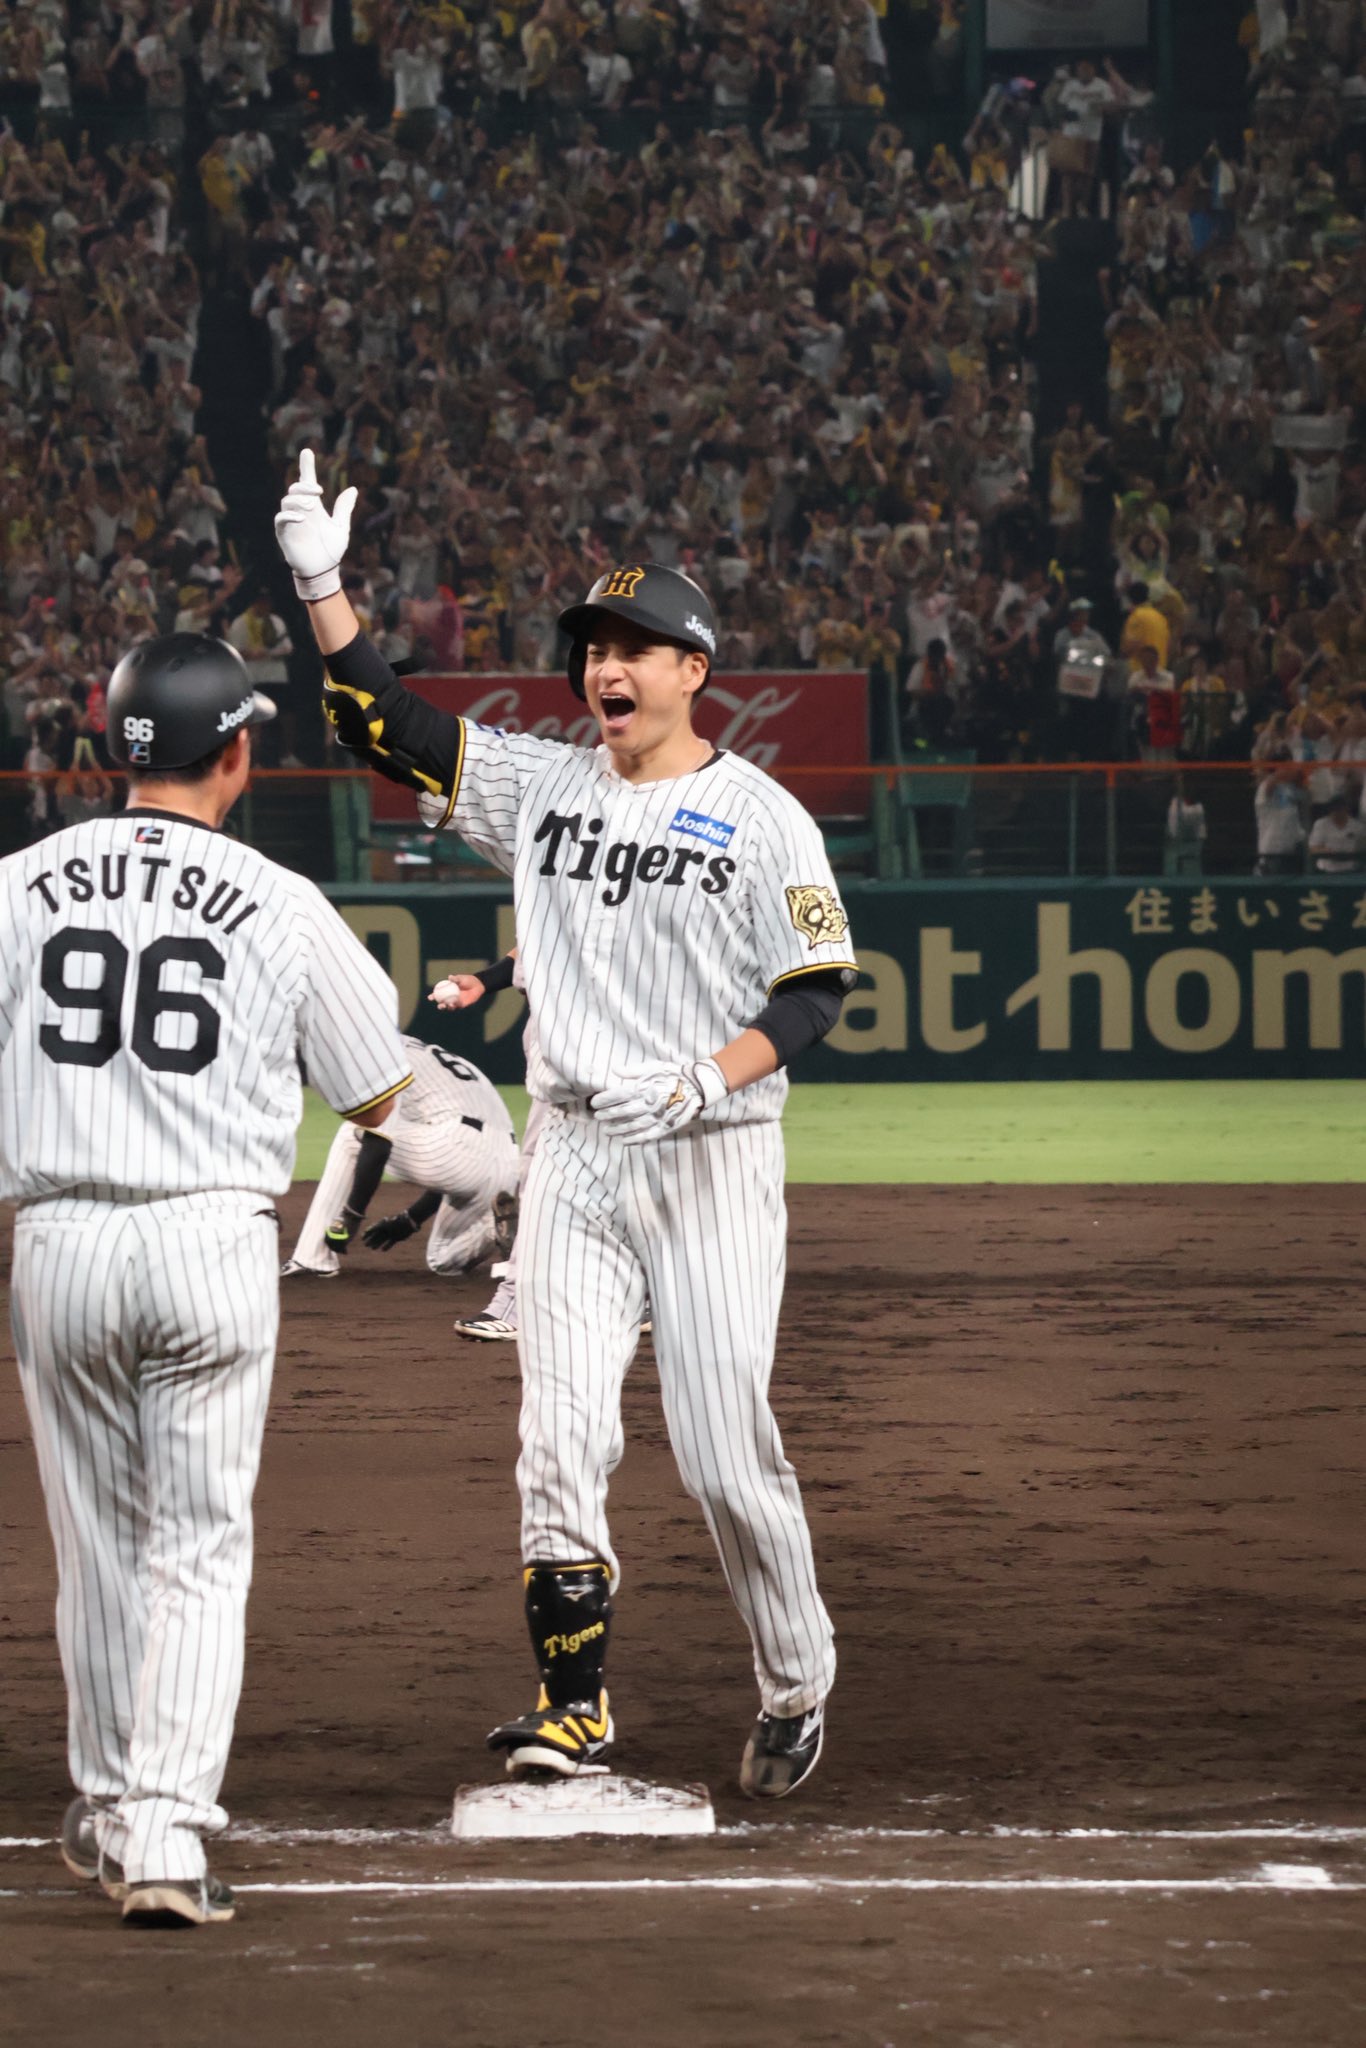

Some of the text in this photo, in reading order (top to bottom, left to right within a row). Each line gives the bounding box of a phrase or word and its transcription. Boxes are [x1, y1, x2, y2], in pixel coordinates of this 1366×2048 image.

[124, 716, 154, 742] 96
[533, 809, 737, 906] Tigers
[672, 813, 731, 844] Joshin
[28, 854, 259, 935] TSUTSUI
[39, 926, 226, 1076] 96
[821, 928, 987, 1054] at
[432, 1048, 479, 1081] 6
[544, 1621, 605, 1658] Tigers
